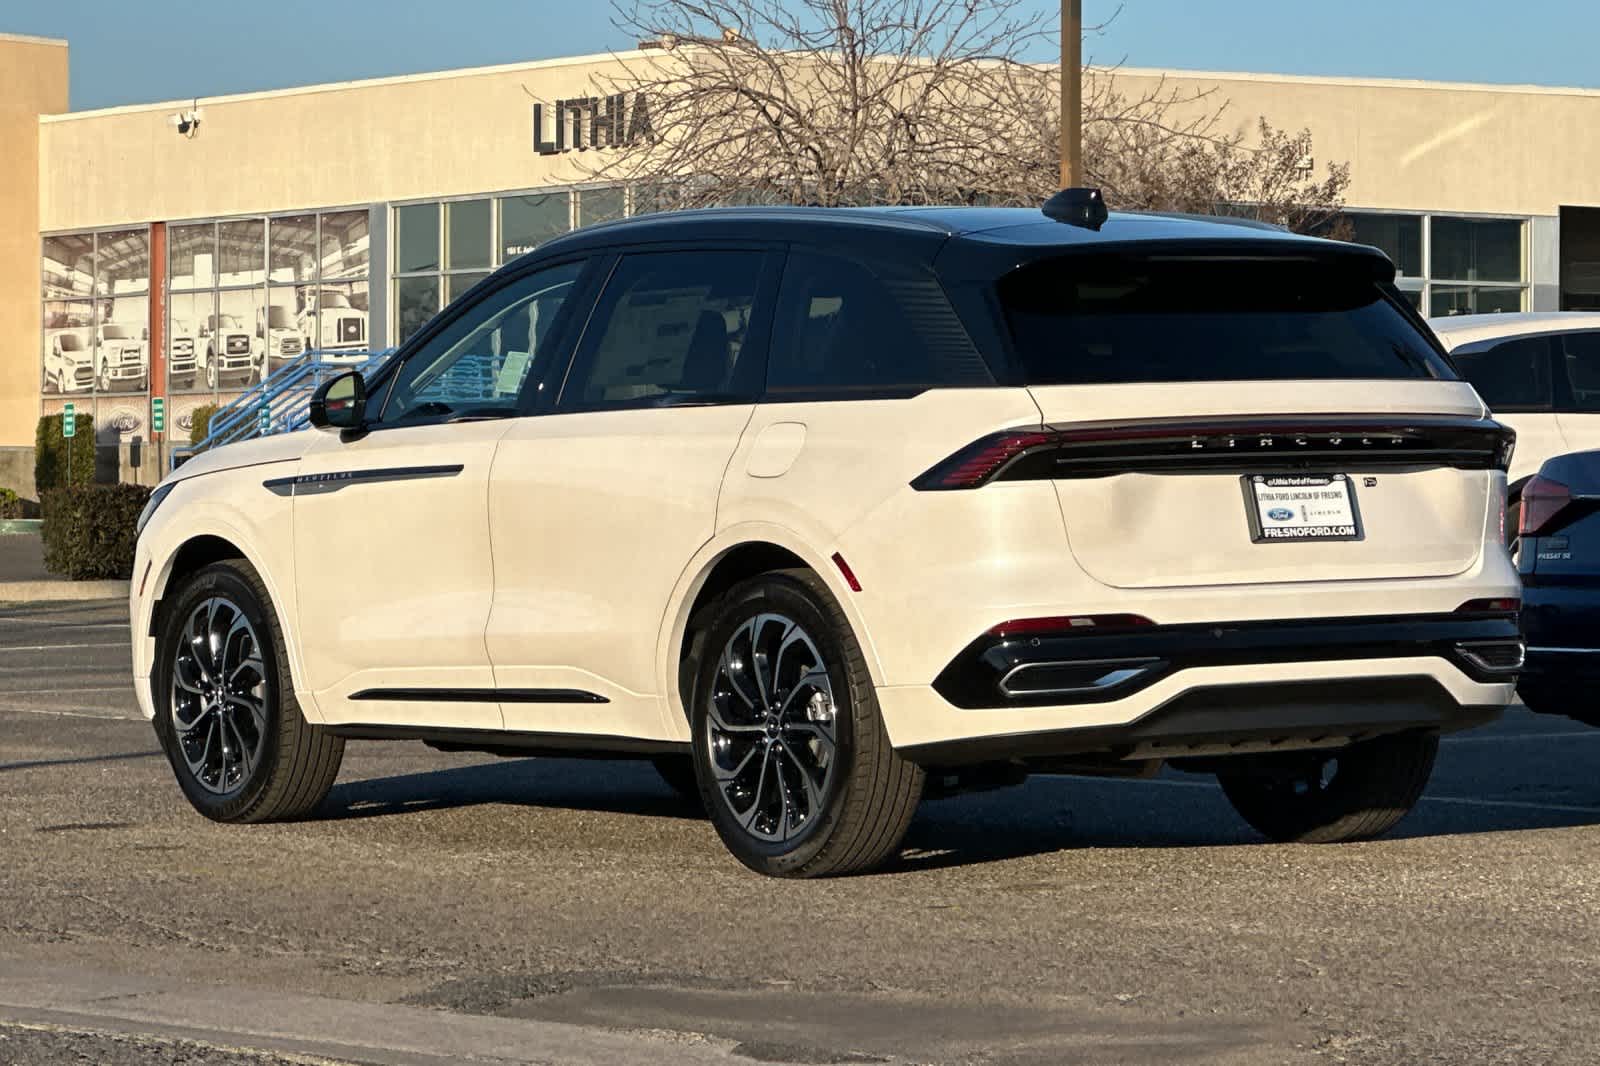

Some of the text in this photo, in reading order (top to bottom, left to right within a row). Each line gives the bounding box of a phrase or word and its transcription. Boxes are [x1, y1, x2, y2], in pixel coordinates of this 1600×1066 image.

[533, 92, 655, 152] LITHIA
[1191, 437, 1403, 449] LINCOLN
[1290, 492, 1312, 500] LINCOLN
[1264, 527, 1355, 537] FRESNOFORD.COM
